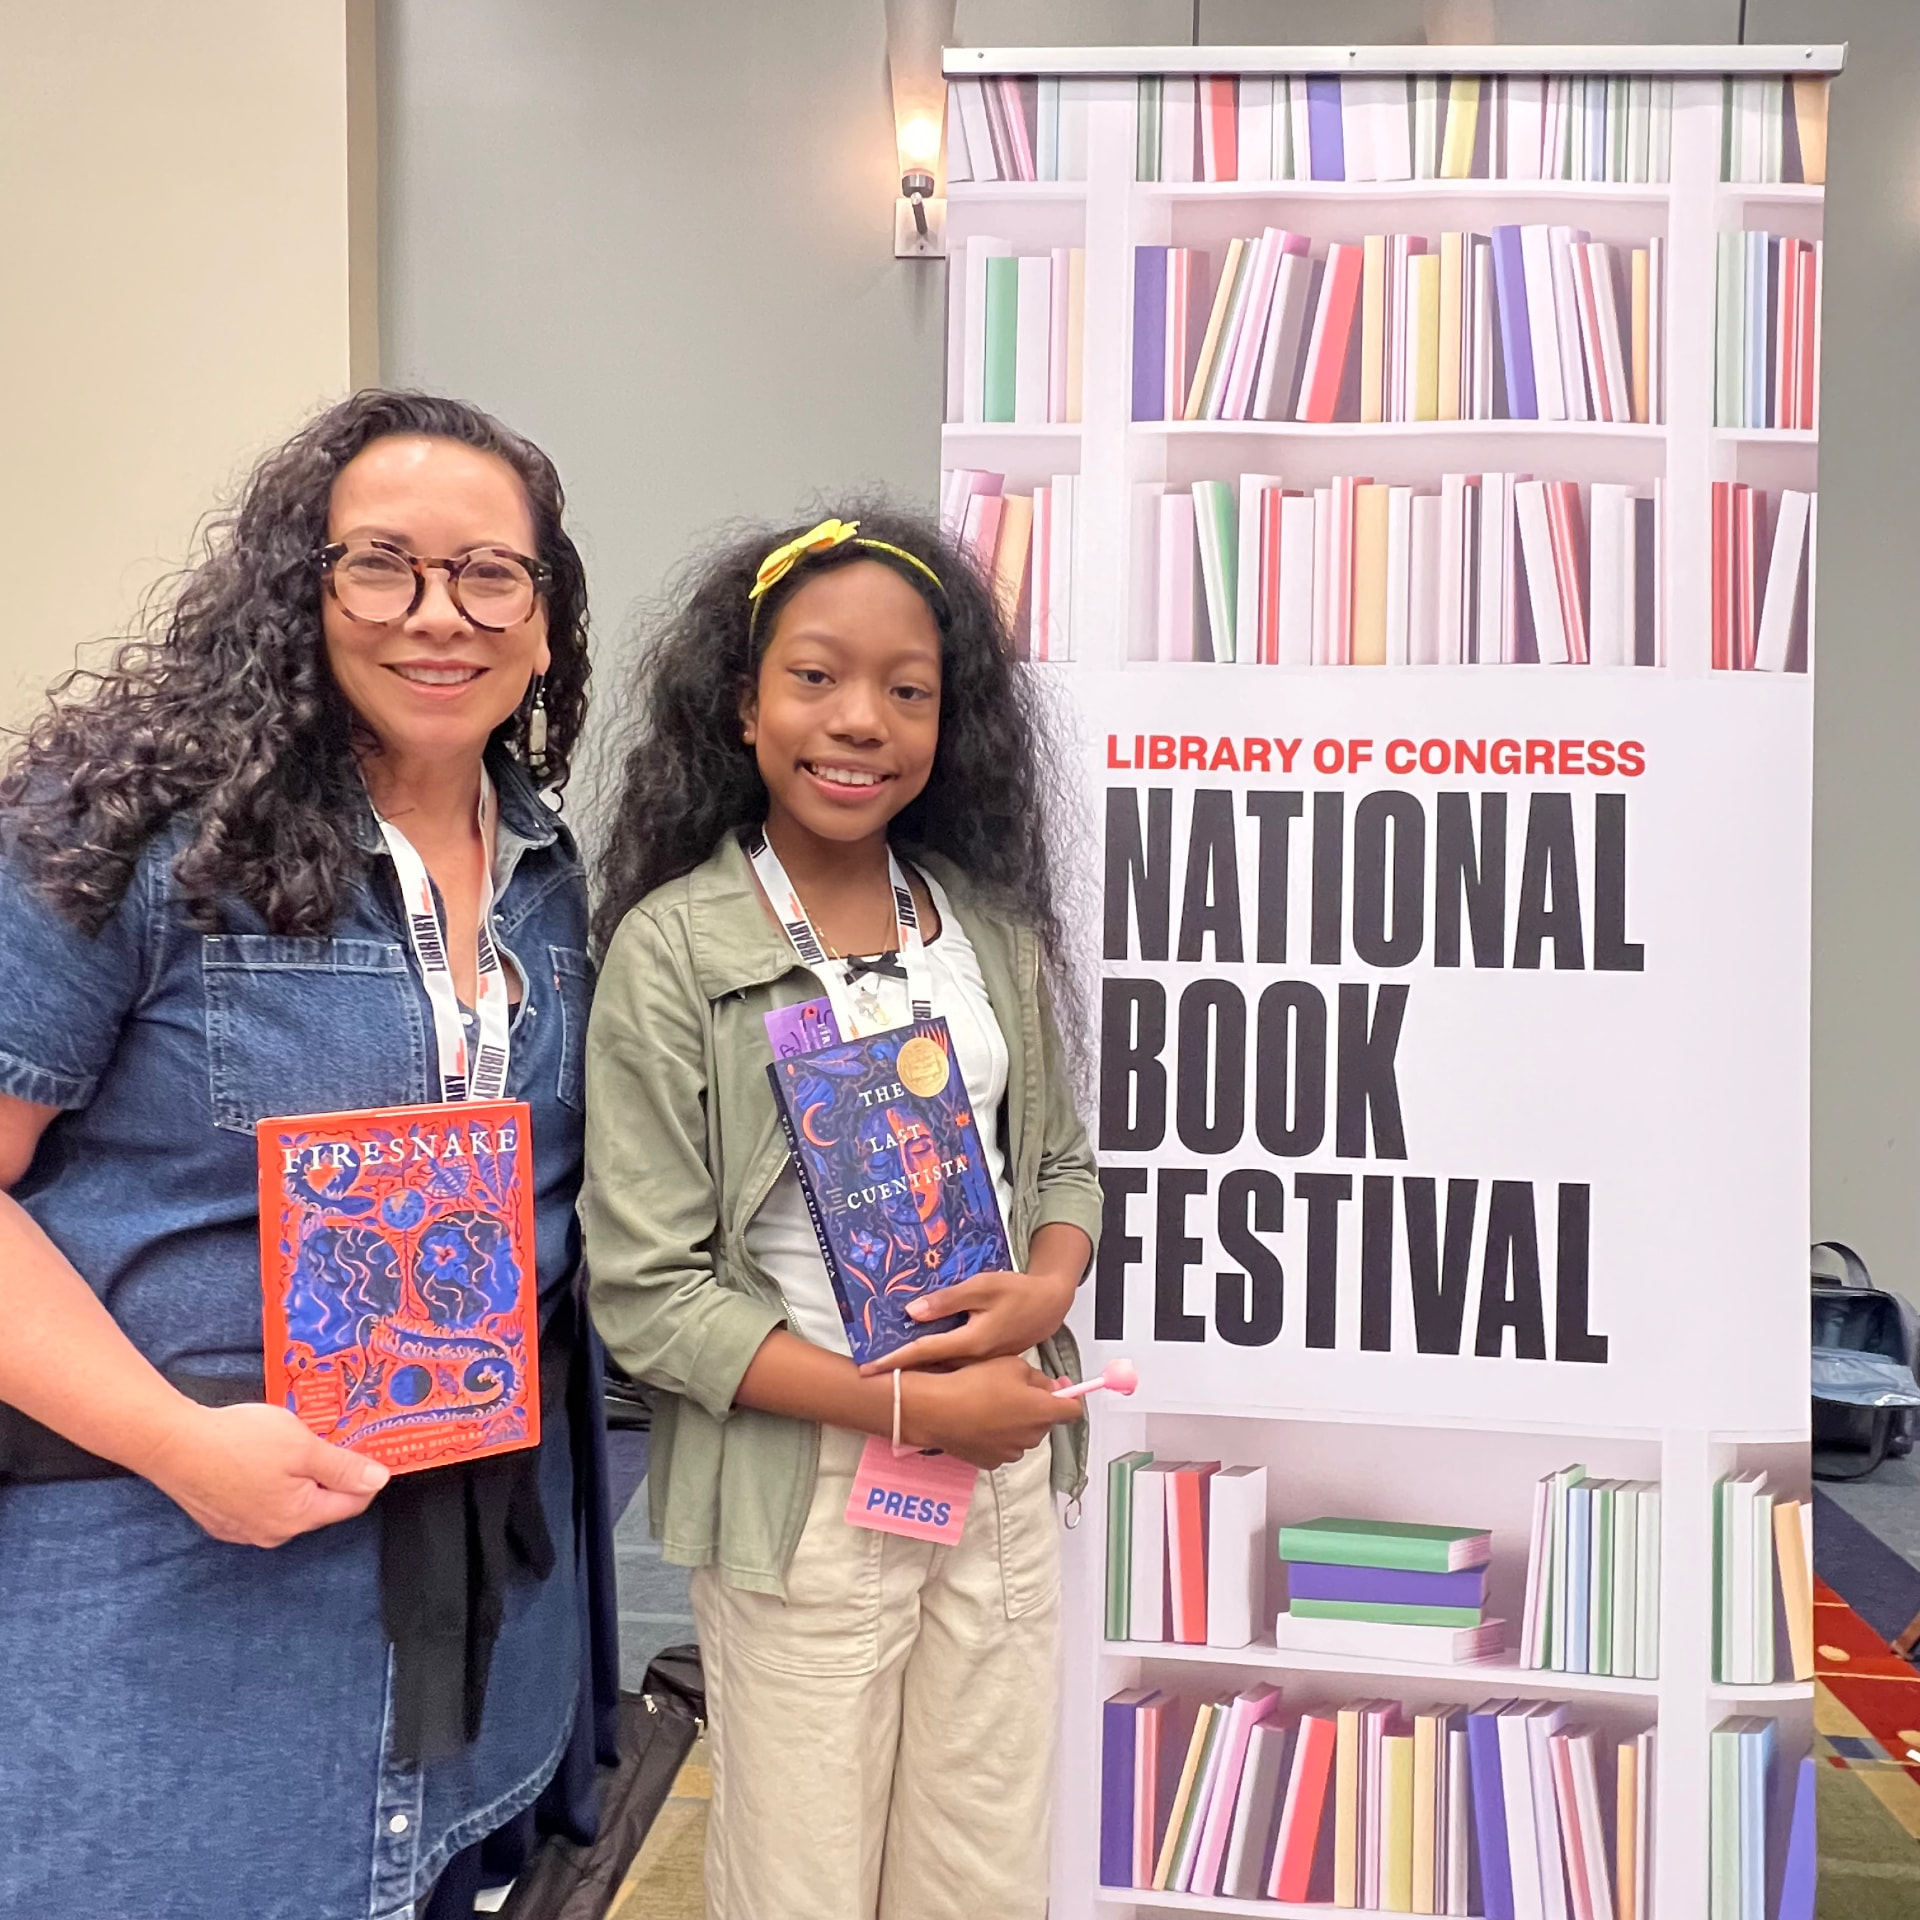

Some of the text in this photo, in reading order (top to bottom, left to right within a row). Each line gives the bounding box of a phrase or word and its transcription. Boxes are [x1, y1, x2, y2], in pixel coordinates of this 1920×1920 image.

[1106, 735, 1647, 777] LIBRARY OF CONGRESS
[1103, 787, 1645, 971] NATIONAL
[411, 913, 447, 972] LIBRARY
[785, 920, 825, 965] LIBRARY
[473, 1044, 506, 1099] LIBRARY
[1099, 977, 1410, 1160] BOOK
[859, 1082, 905, 1108] THE
[282, 1128, 518, 1174] FIRESNAKE
[869, 1124, 921, 1154] LAST
[792, 1151, 808, 1186] LAST
[847, 1159, 968, 1209] CUENTISTA
[1094, 1166, 1609, 1363] FESTIVAL
[866, 1487, 951, 1526] PRESS
